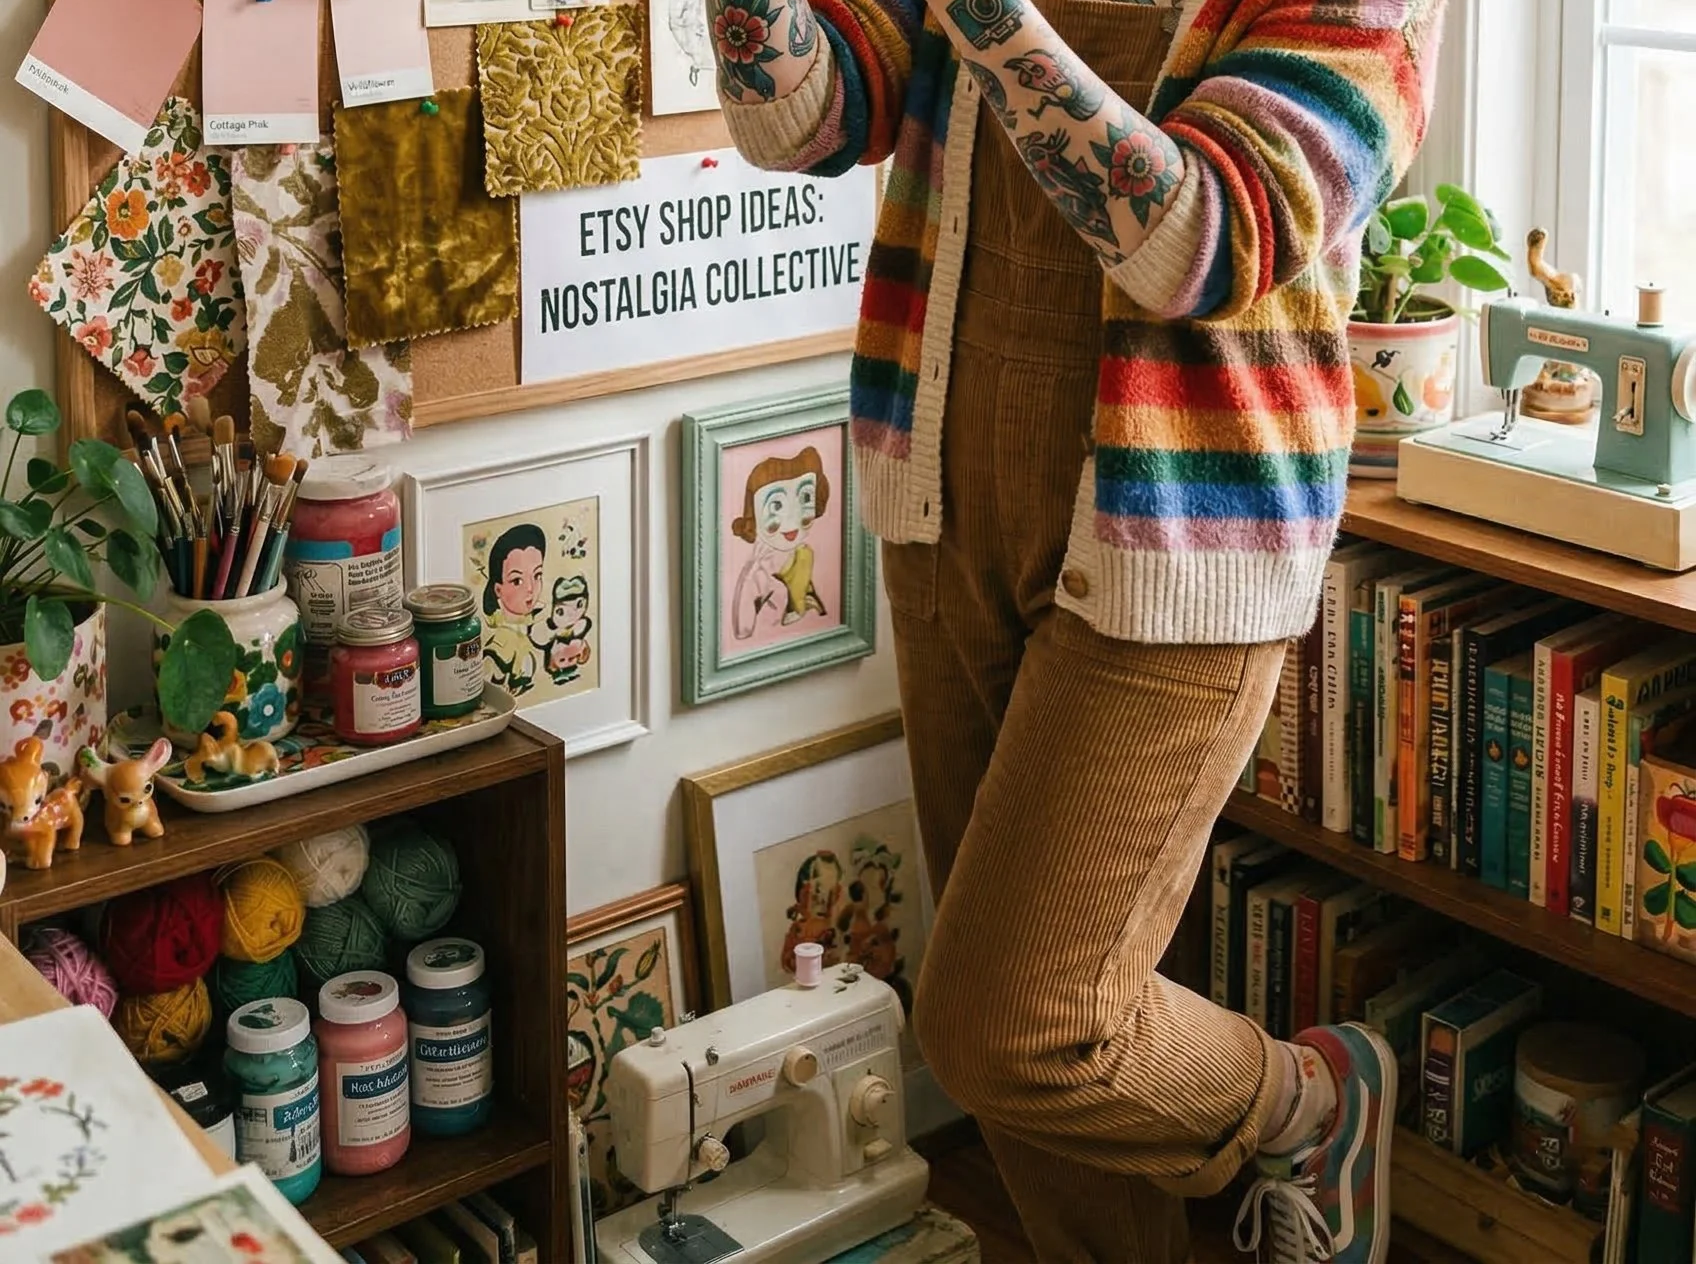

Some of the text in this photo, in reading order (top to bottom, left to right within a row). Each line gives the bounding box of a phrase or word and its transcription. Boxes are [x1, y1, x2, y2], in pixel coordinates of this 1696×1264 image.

[580, 183, 824, 257] ETSY SHOP IDEAS:
[541, 242, 860, 333] NOSTALGIA COLLECTIVE
